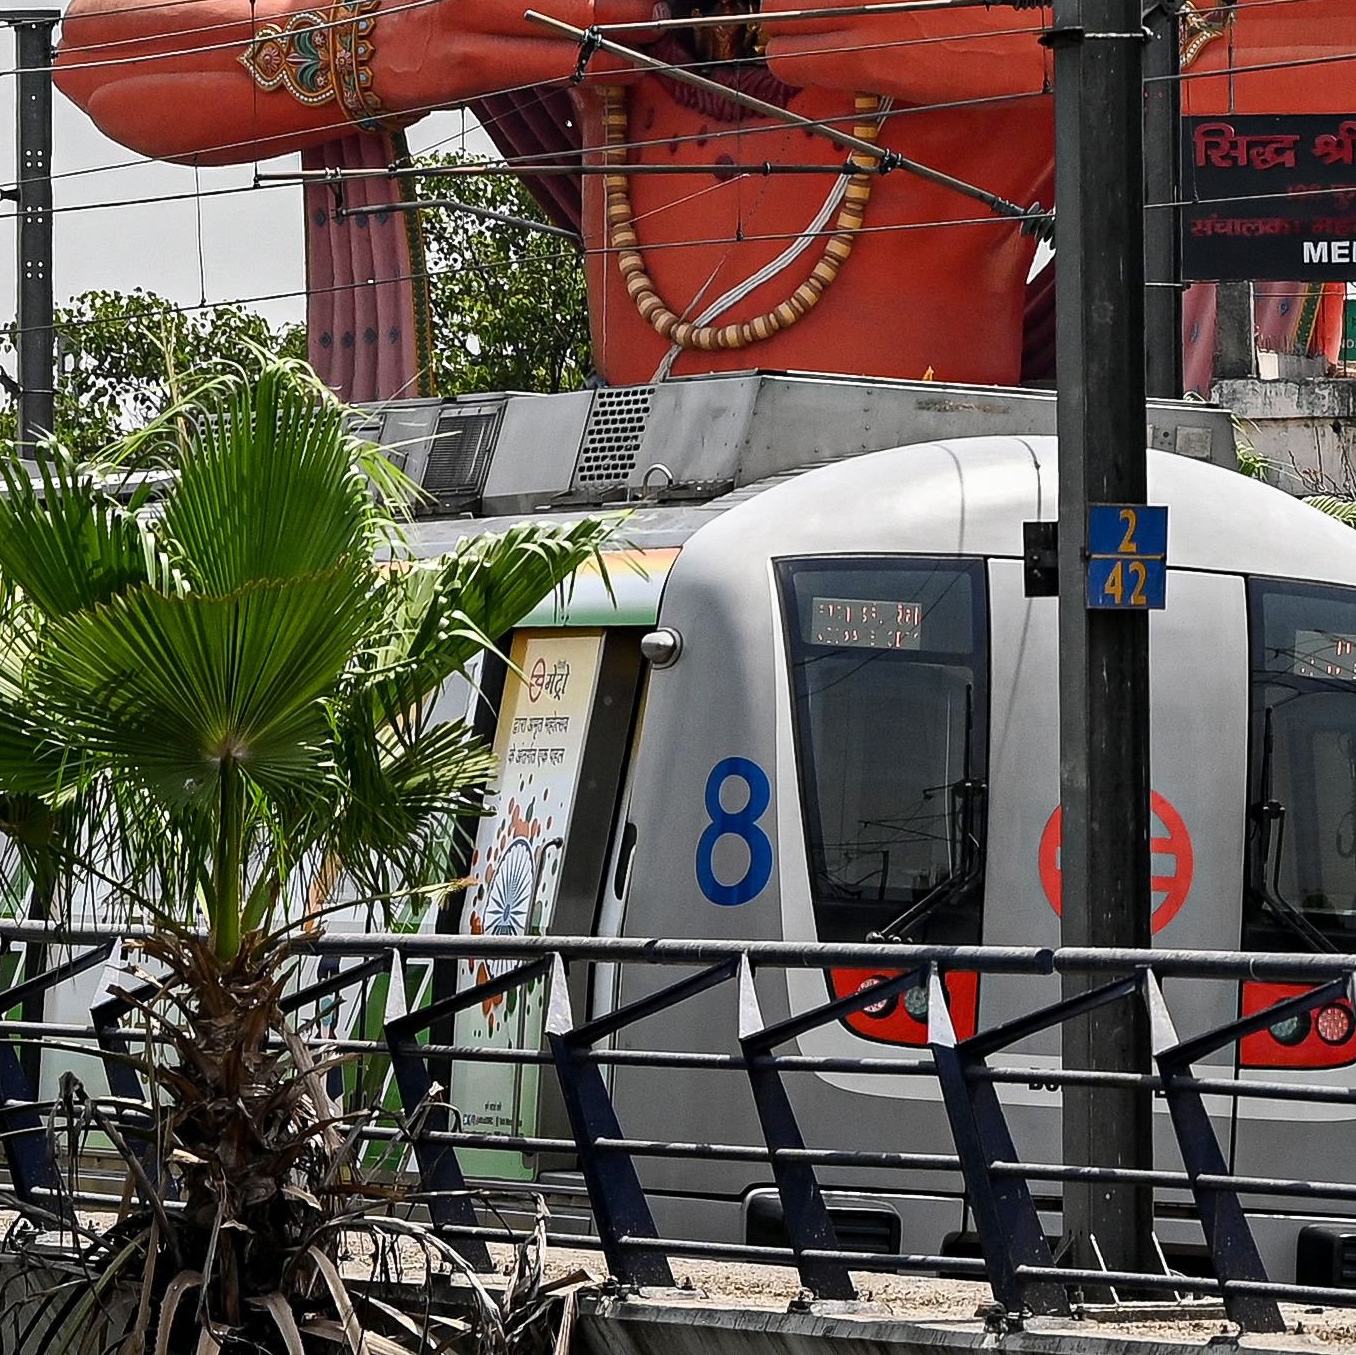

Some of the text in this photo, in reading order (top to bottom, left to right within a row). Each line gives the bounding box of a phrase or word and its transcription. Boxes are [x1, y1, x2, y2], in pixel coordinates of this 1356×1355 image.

[1193, 123, 1299, 170] सिद्ध
[1118, 509, 1137, 553] 2
[1104, 560, 1148, 605] 42
[695, 756, 773, 907] 8
